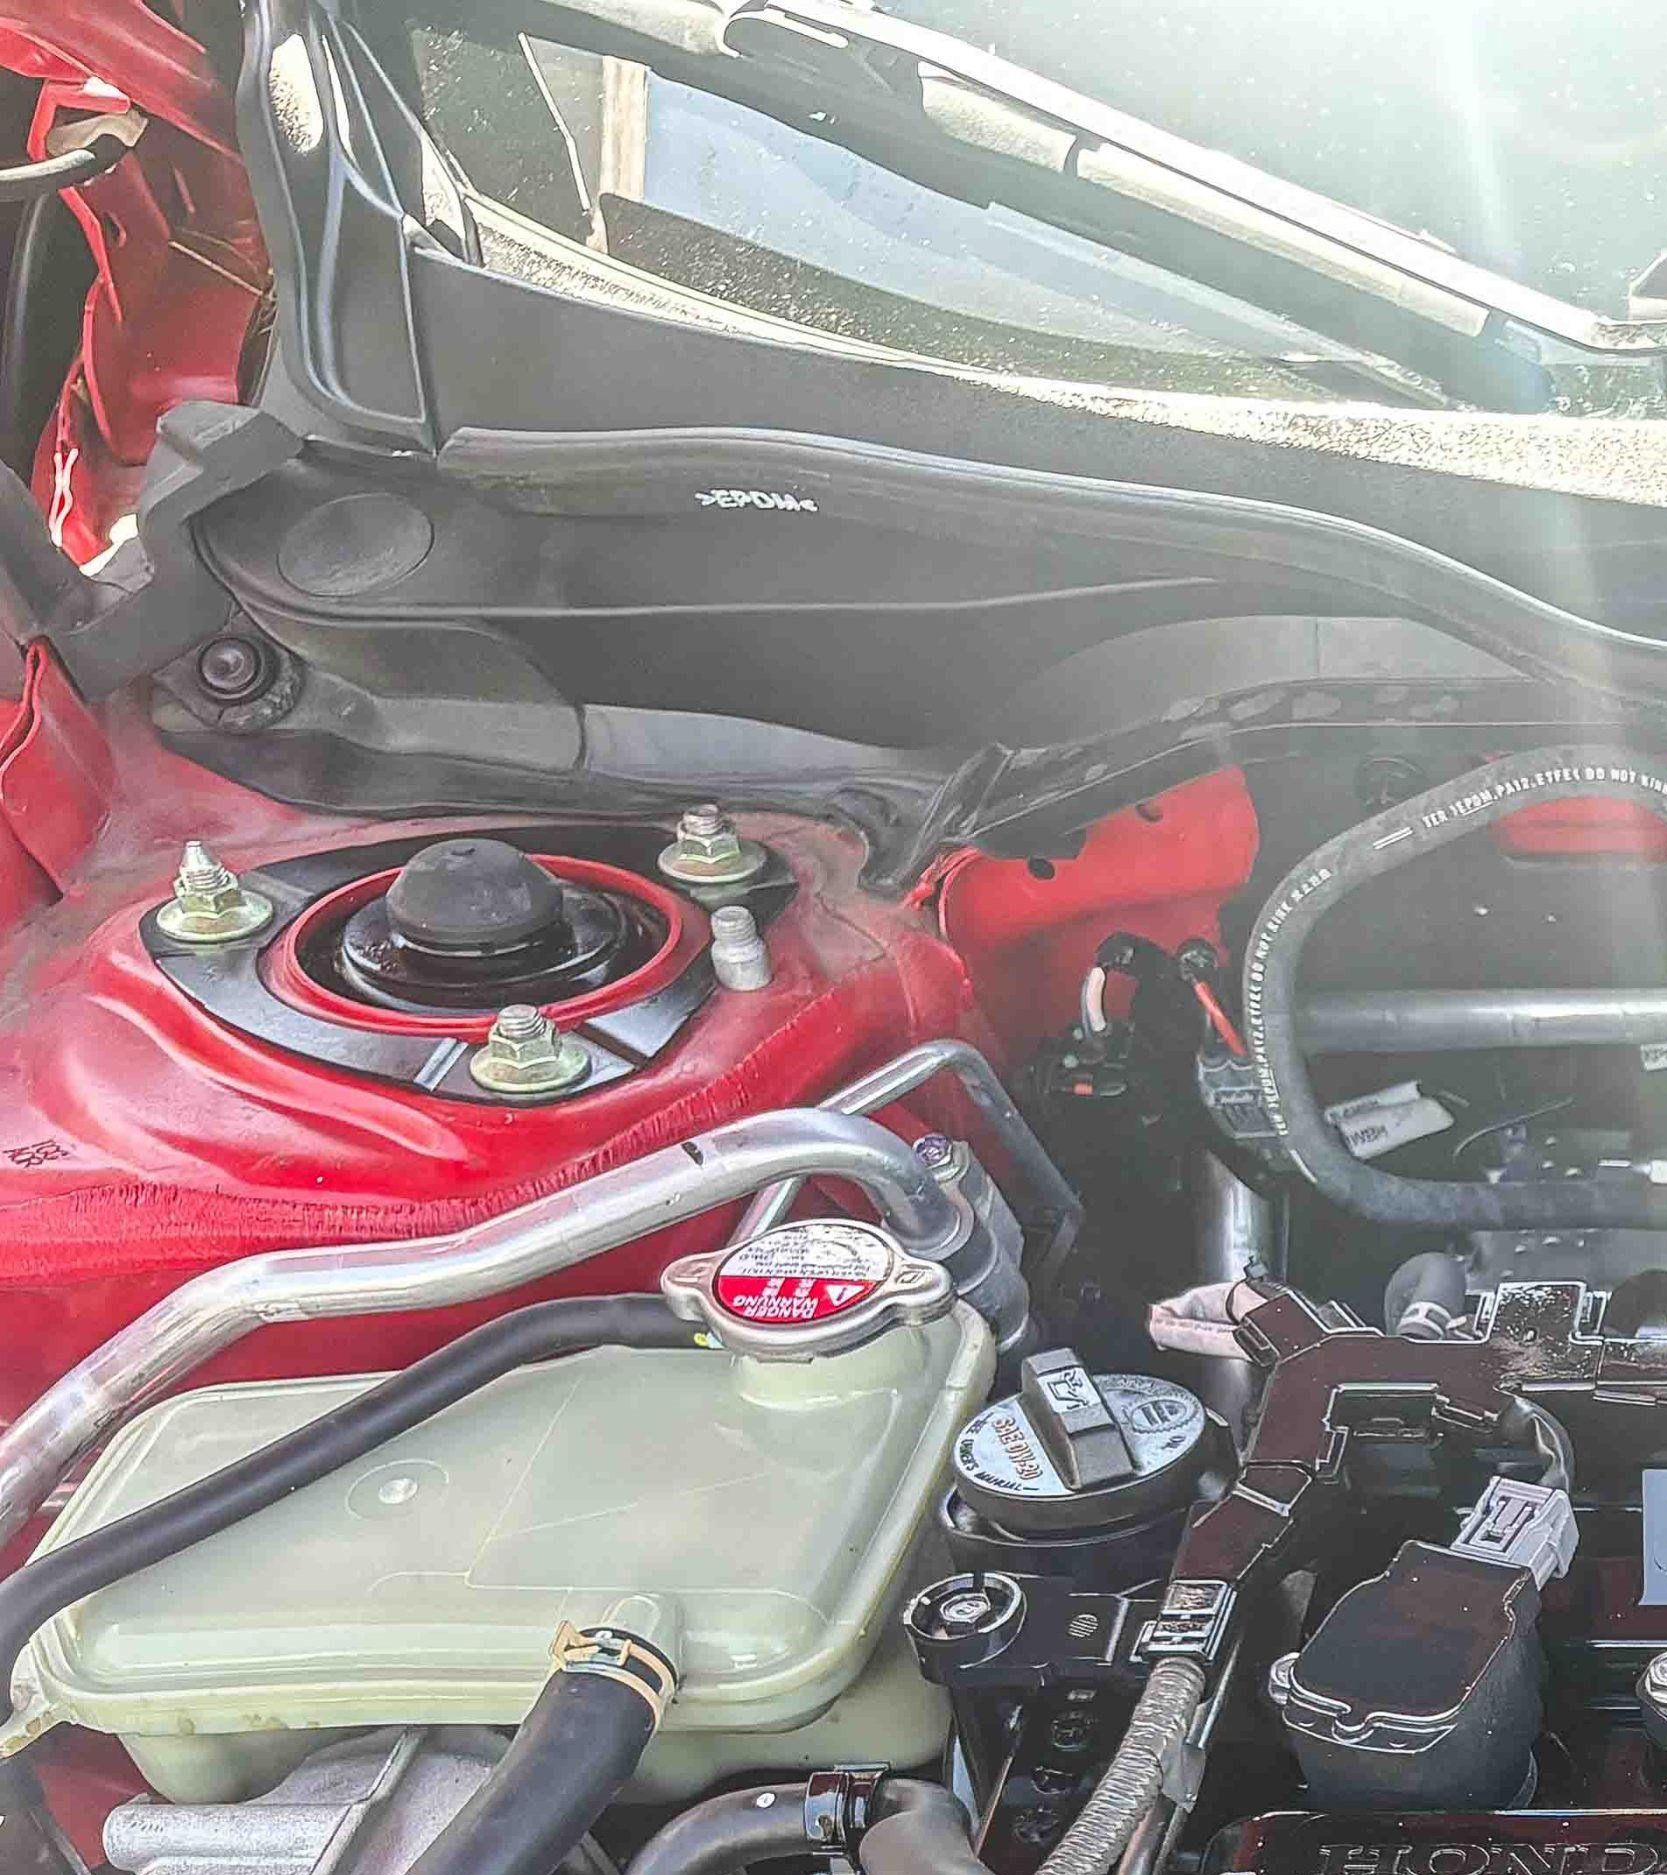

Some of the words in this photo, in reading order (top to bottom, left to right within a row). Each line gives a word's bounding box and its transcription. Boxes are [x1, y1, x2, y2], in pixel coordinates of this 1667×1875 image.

[1611, 769, 1636, 784] NOT
[733, 1295, 818, 1311] WARNUNG
[744, 1305, 816, 1319] DANGER
